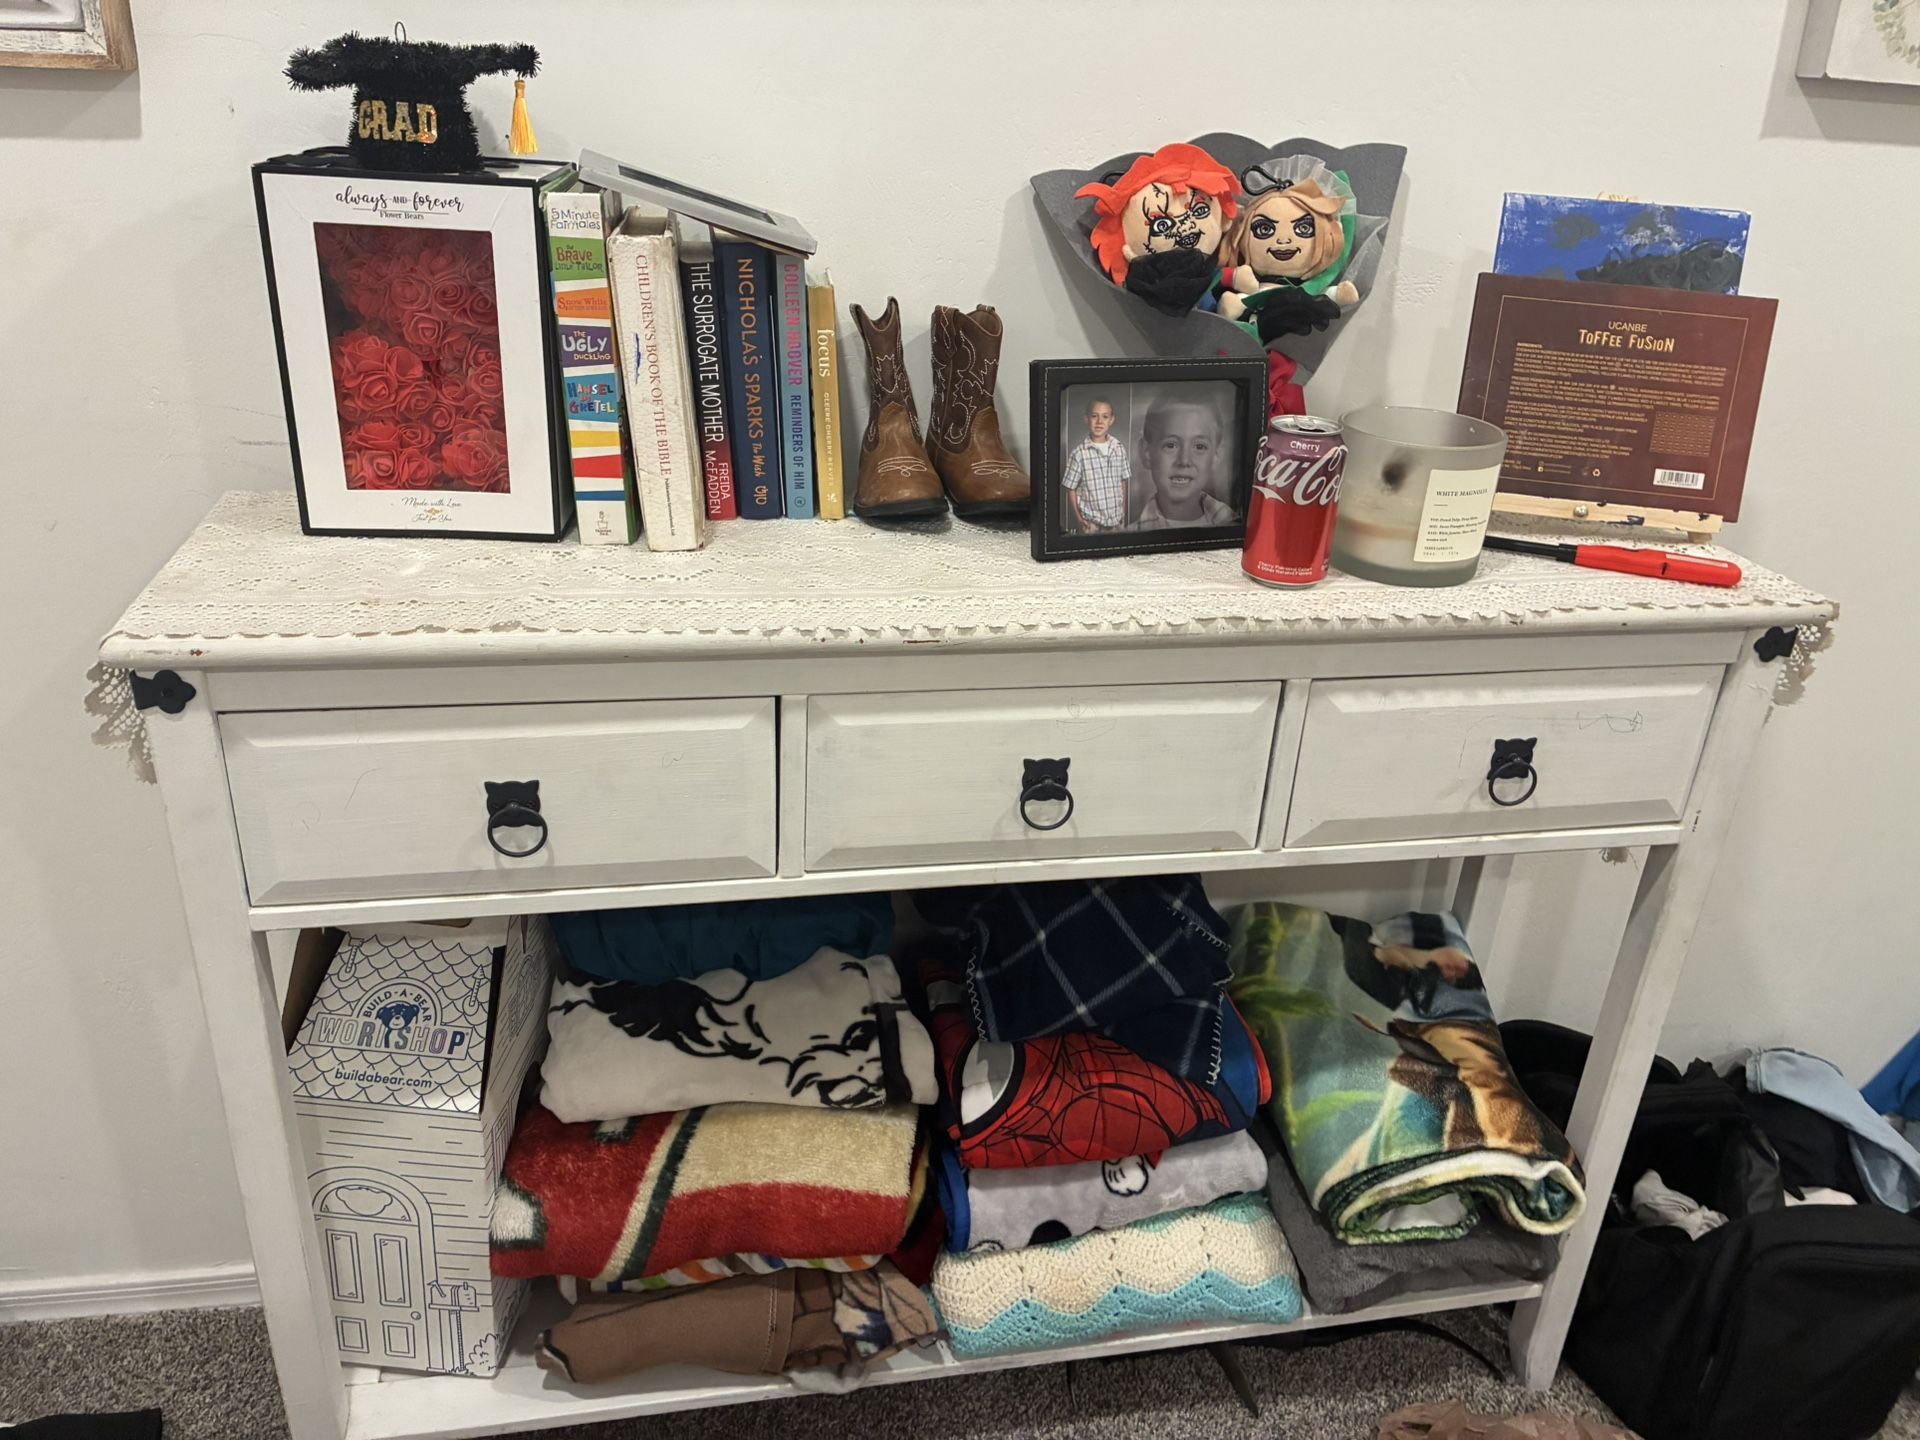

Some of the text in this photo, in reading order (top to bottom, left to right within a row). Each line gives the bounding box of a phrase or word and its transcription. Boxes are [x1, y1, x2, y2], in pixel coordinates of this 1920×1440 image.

[358, 99, 438, 144] GRAD
[336, 185, 465, 213] always AND forever
[551, 207, 600, 220] 5 Minute
[562, 334, 608, 353] UGLY
[783, 263, 803, 386] COLLEEN HOOVER
[1608, 320, 1648, 333] UCANBE
[635, 254, 672, 476] CHILDREN'S BOOK OF THE BIBLE
[690, 263, 724, 443] THE SURROGATE MOTHER
[737, 258, 764, 439] NICHOLAS SPARKS
[816, 328, 835, 378] focus
[569, 399, 616, 414] GRETEL
[790, 394, 805, 490] REMINDERS OF HIM
[1290, 440, 1321, 452] Cherry
[705, 450, 721, 514] McFADDEN
[718, 462, 731, 500] FREIDA
[753, 455, 766, 478] Wish
[335, 1068, 432, 1089] buildabear.com
